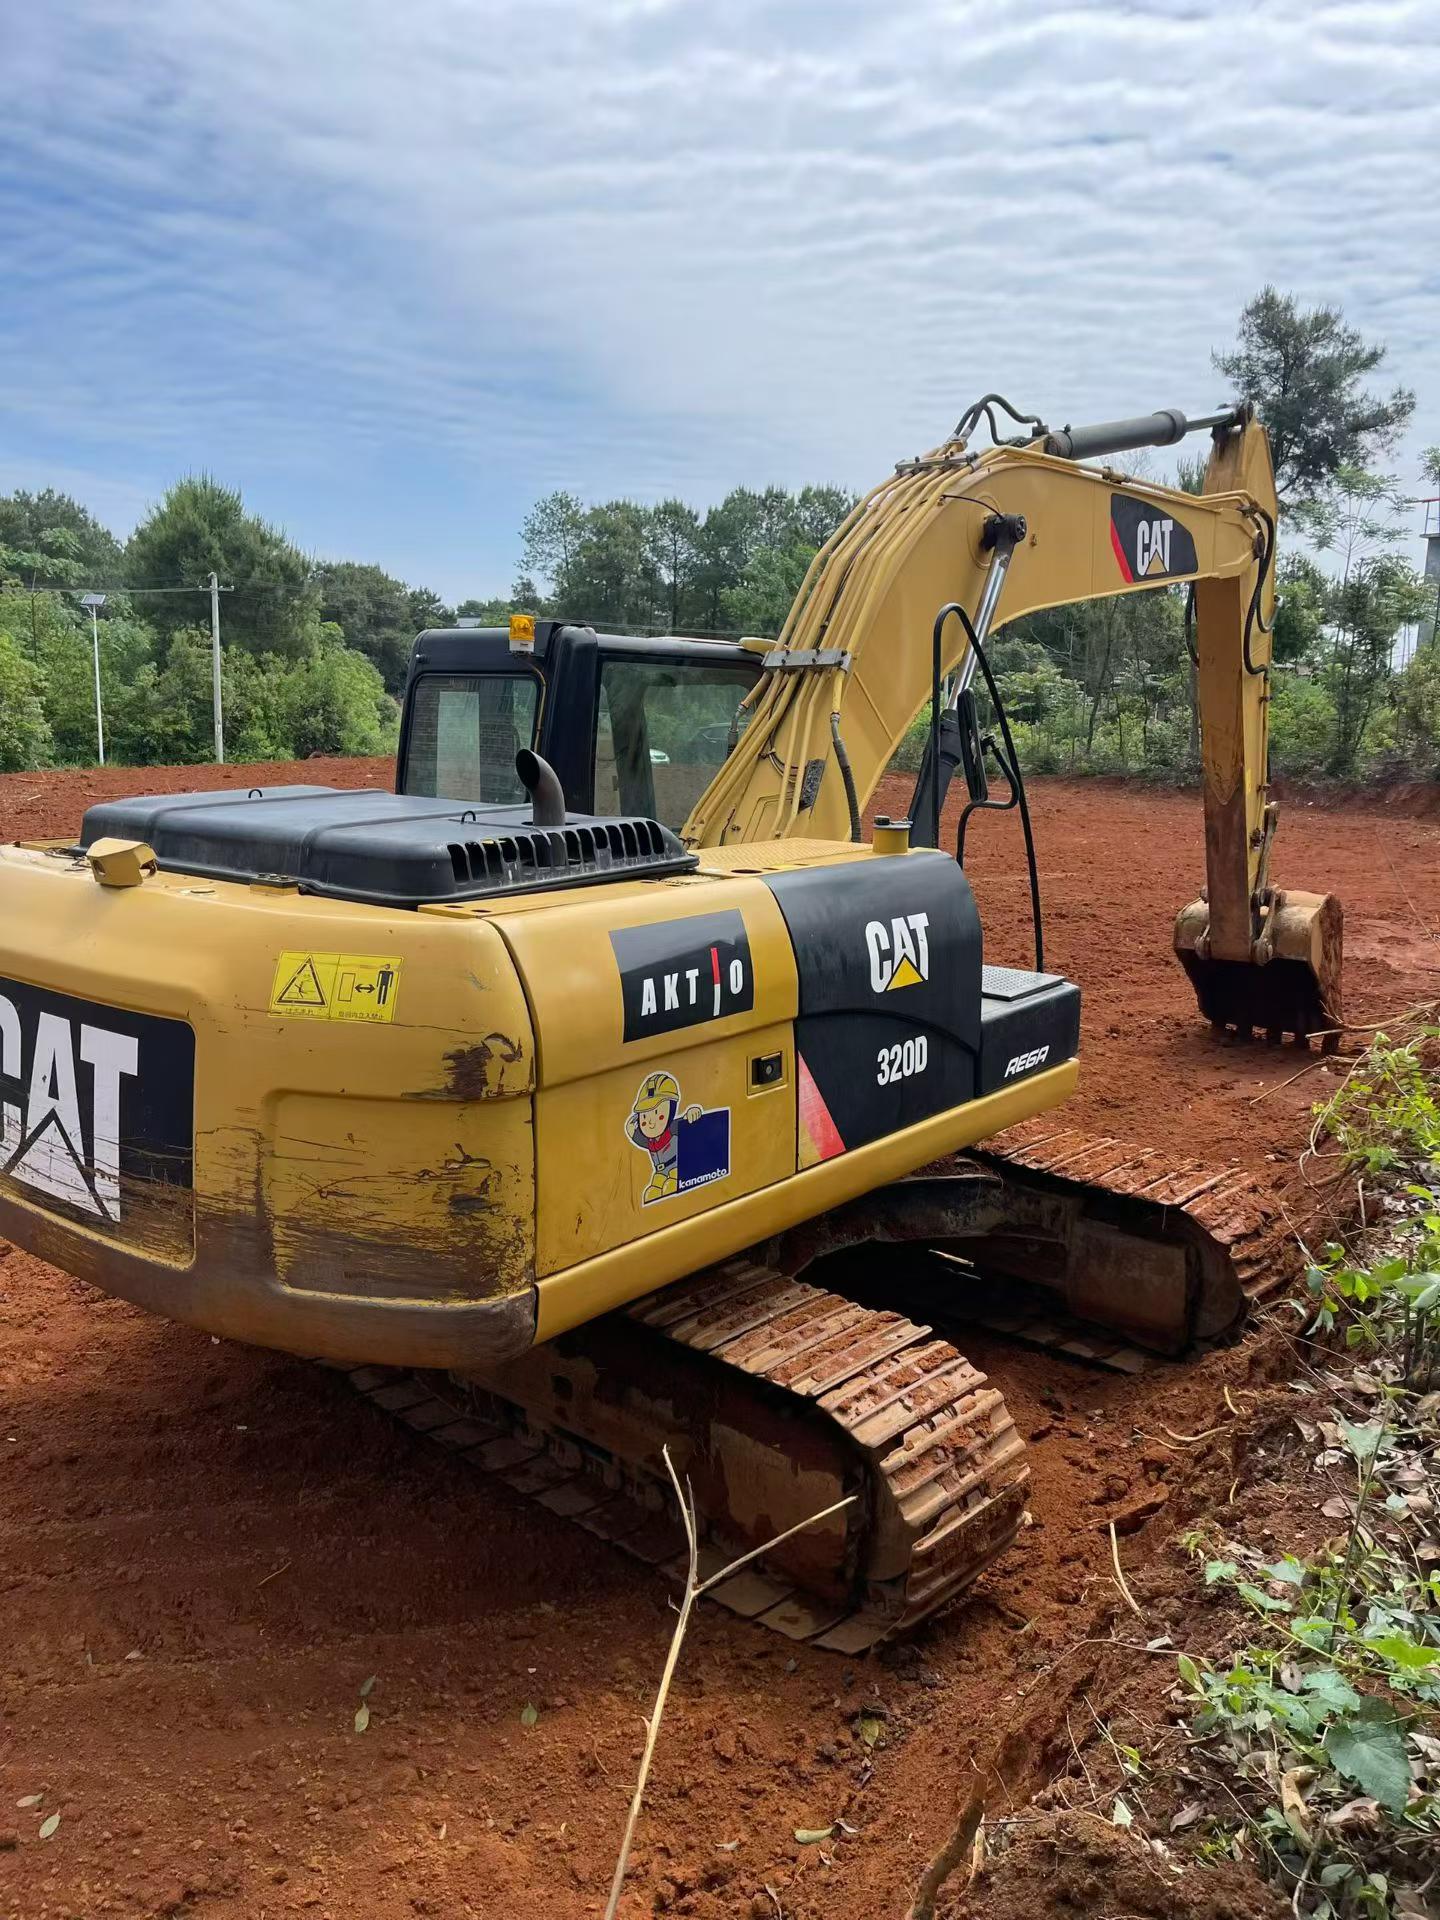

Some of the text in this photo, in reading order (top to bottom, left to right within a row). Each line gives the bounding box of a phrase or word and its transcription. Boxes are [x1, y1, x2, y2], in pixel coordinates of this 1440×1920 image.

[1136, 519, 1173, 576] CAT
[865, 912, 930, 993] CAT
[641, 947, 743, 1017] AKTIO
[877, 1035, 928, 1086] 320D
[1004, 1045, 1050, 1078] REGA
[679, 1168, 727, 1189] kanamoto
